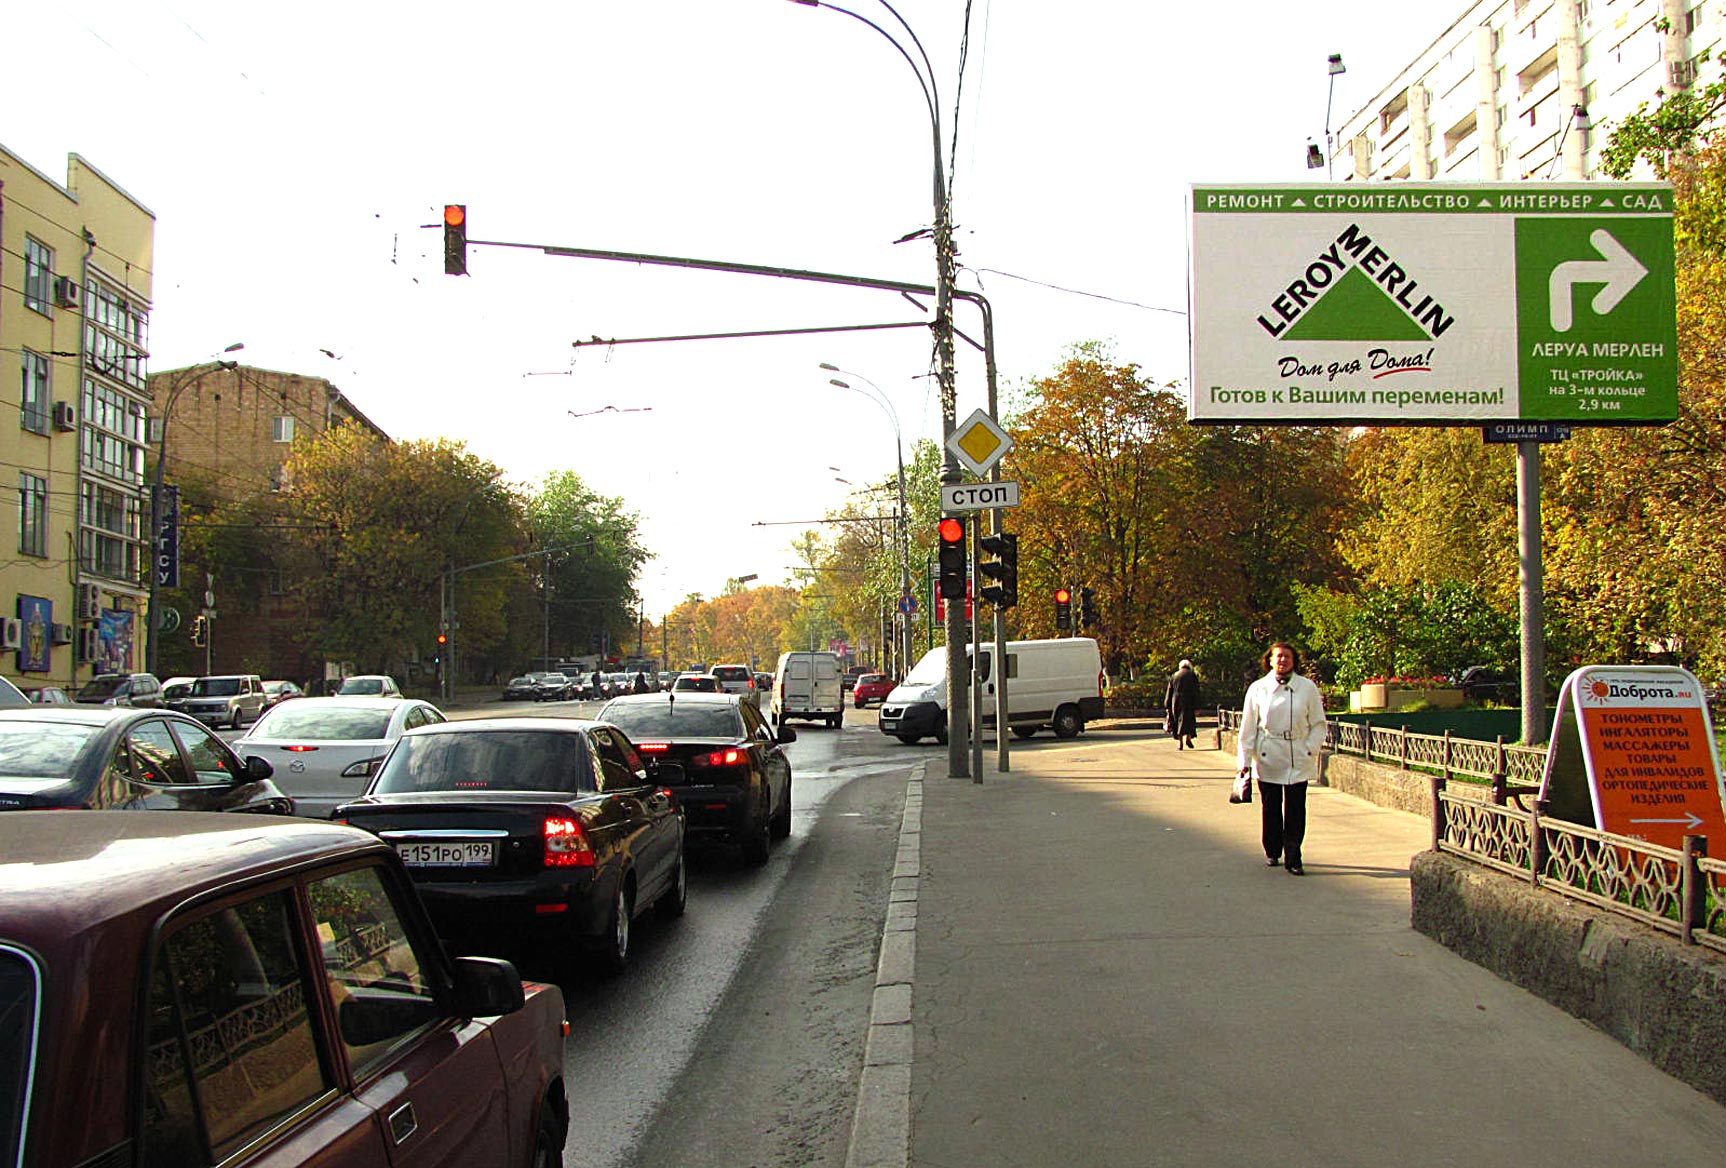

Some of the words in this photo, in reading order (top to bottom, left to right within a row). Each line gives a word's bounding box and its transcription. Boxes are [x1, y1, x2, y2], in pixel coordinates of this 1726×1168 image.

[1206, 194, 1284, 209] РЕМОНТ
[1313, 194, 1470, 209] СТРОИТЕЛЬСТВО
[1499, 194, 1593, 209] ИНТЕРЬЕР
[1621, 194, 1663, 211] САД
[1256, 242, 1346, 338] LEROY
[1336, 223, 1455, 338] MERLIN
[1531, 342, 1589, 357] ЛЕРУА
[1593, 342, 1664, 357] МЕРЛЕН
[1278, 356, 1323, 378] Дом
[1328, 362, 1362, 382] для
[1367, 347, 1435, 370] Дома!
[1550, 369, 1570, 382] ТЦ
[1571, 368, 1644, 382] «ТРОЙКА»
[1209, 386, 1267, 404] Готов
[1271, 390, 1284, 404] к
[1288, 386, 1366, 405] Вашим
[1372, 387, 1504, 408] переменам!
[1549, 387, 1566, 396] на
[1569, 384, 1595, 396] 3-м
[1597, 387, 1647, 397] кольце
[1578, 399, 1599, 411] 2,9
[1601, 401, 1621, 411] км
[952, 487, 1007, 506] СТОП
[1602, 713, 1684, 724] ТОНОМЕТРЫ
[1600, 727, 1690, 738] ИНГАЛЯТОРЫ
[1603, 740, 1690, 751] МАССАЖЕРЫ
[1627, 754, 1678, 764] ТОВАРЫ
[1604, 767, 1629, 779] ДЛЯ
[1632, 767, 1706, 779] ИНВАЛИДОВ
[1602, 780, 1710, 792] ОРТОПЕДИЧЕСКИЕ
[1631, 793, 1686, 805] ИЗДЕЛИЯ
[465, 844, 490, 857] 199
